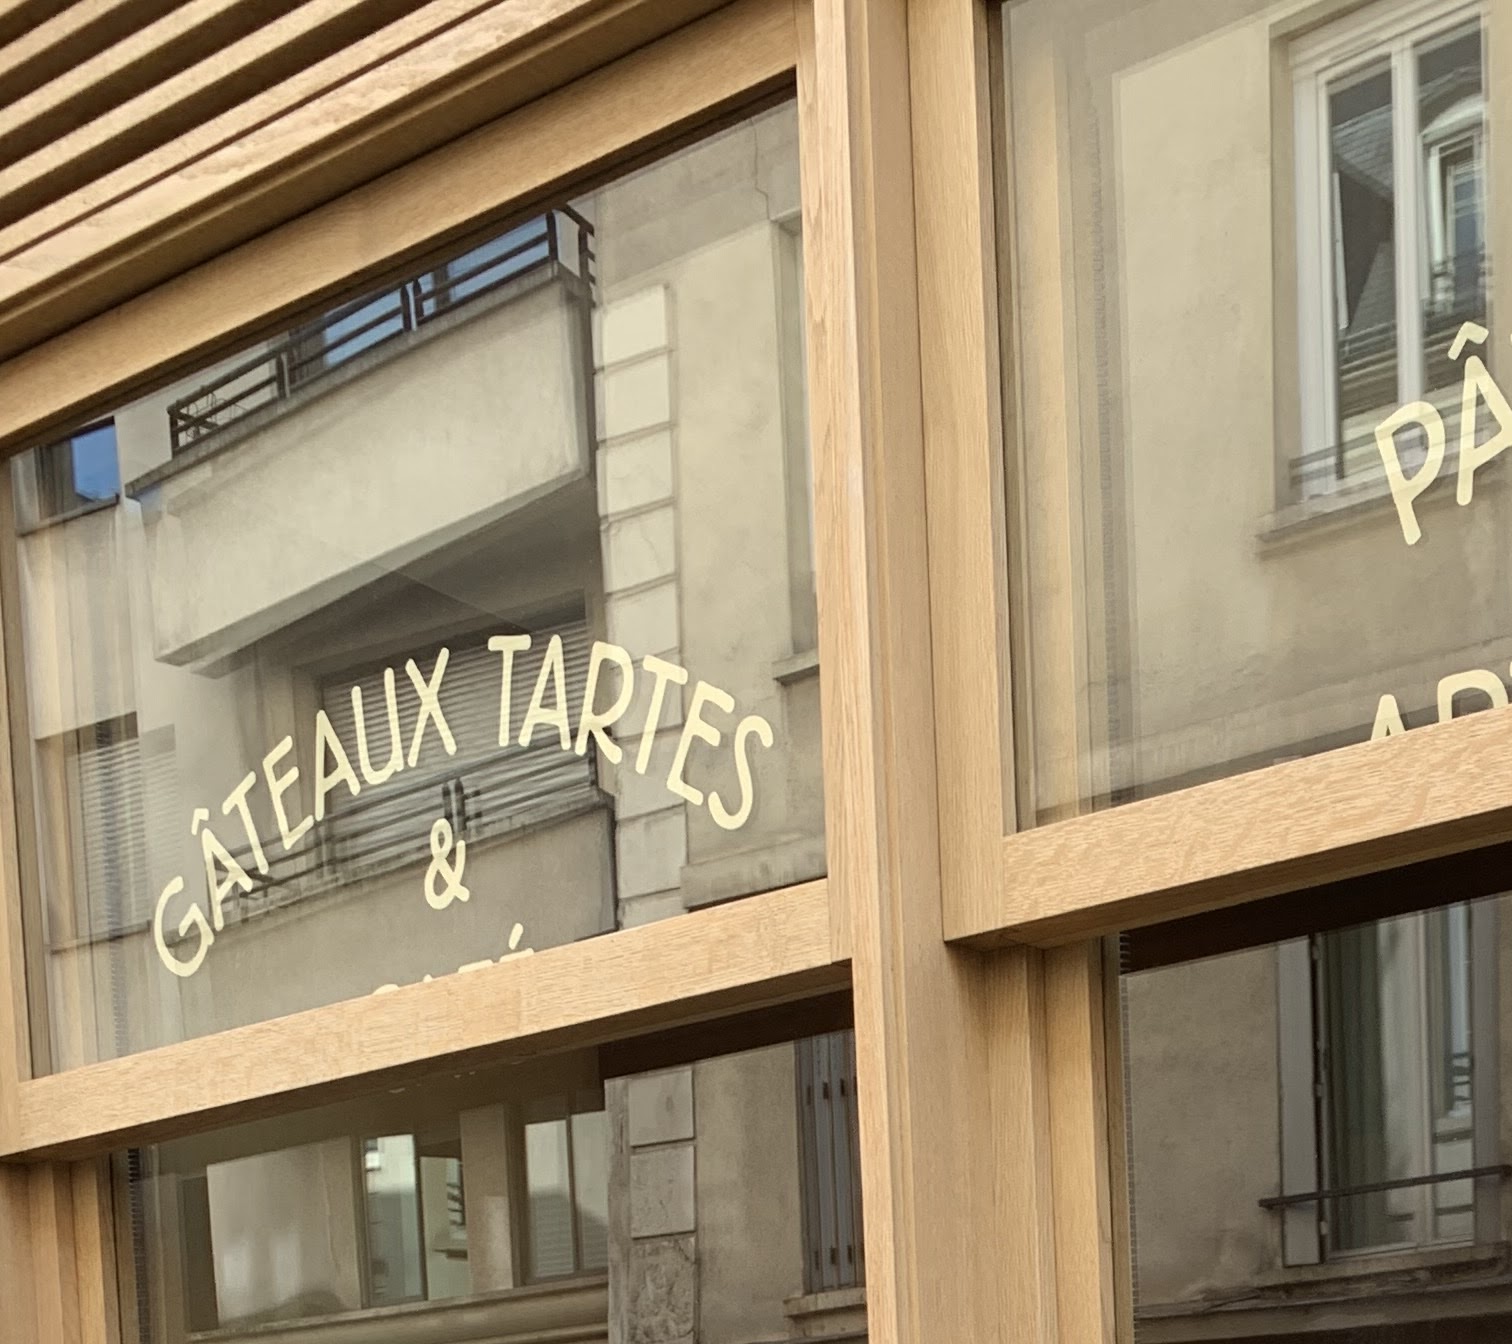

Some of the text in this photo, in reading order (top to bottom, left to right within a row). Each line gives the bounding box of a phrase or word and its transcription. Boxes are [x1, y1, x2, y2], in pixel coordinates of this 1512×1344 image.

[153, 634, 775, 978] GÂTEAUX TARTES
[423, 818, 470, 911] &
